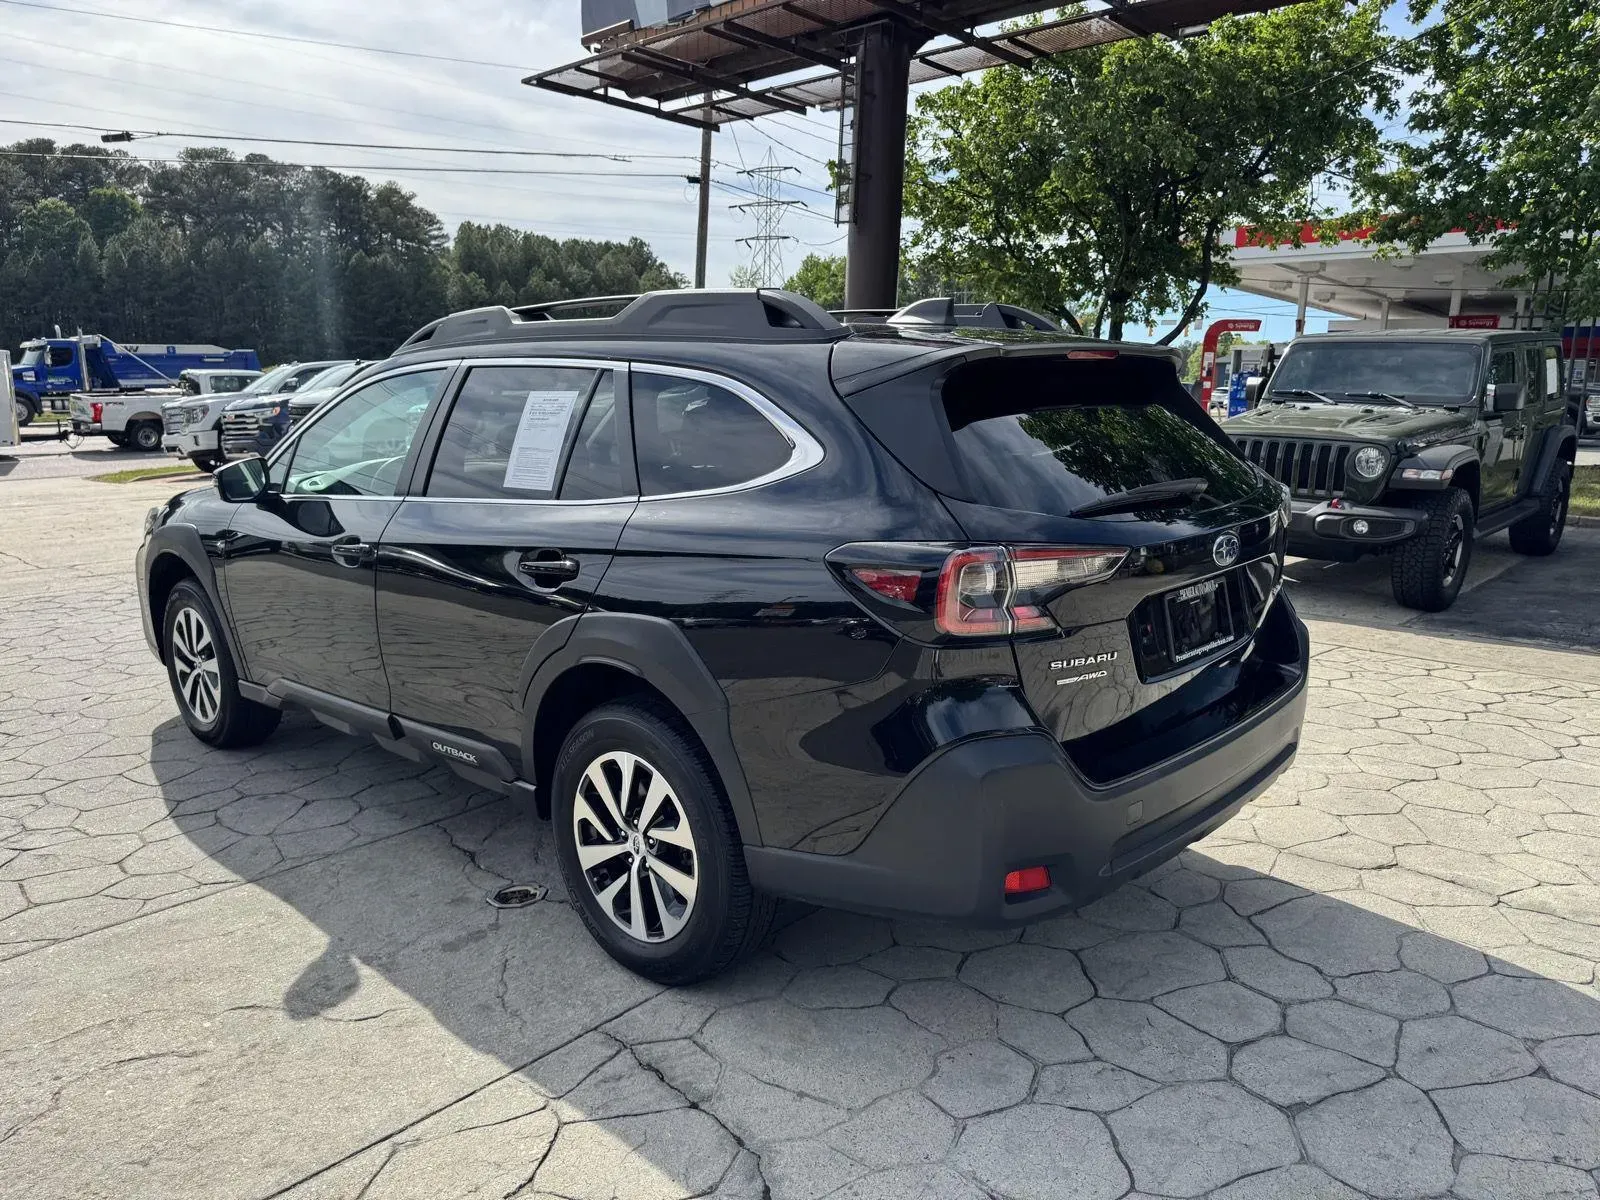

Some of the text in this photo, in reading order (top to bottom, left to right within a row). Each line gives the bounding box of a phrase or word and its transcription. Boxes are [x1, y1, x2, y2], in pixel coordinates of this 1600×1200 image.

[1050, 651, 1118, 670] SUBARU
[1077, 670, 1108, 682] AWD
[432, 742, 478, 763] OUTBACK
